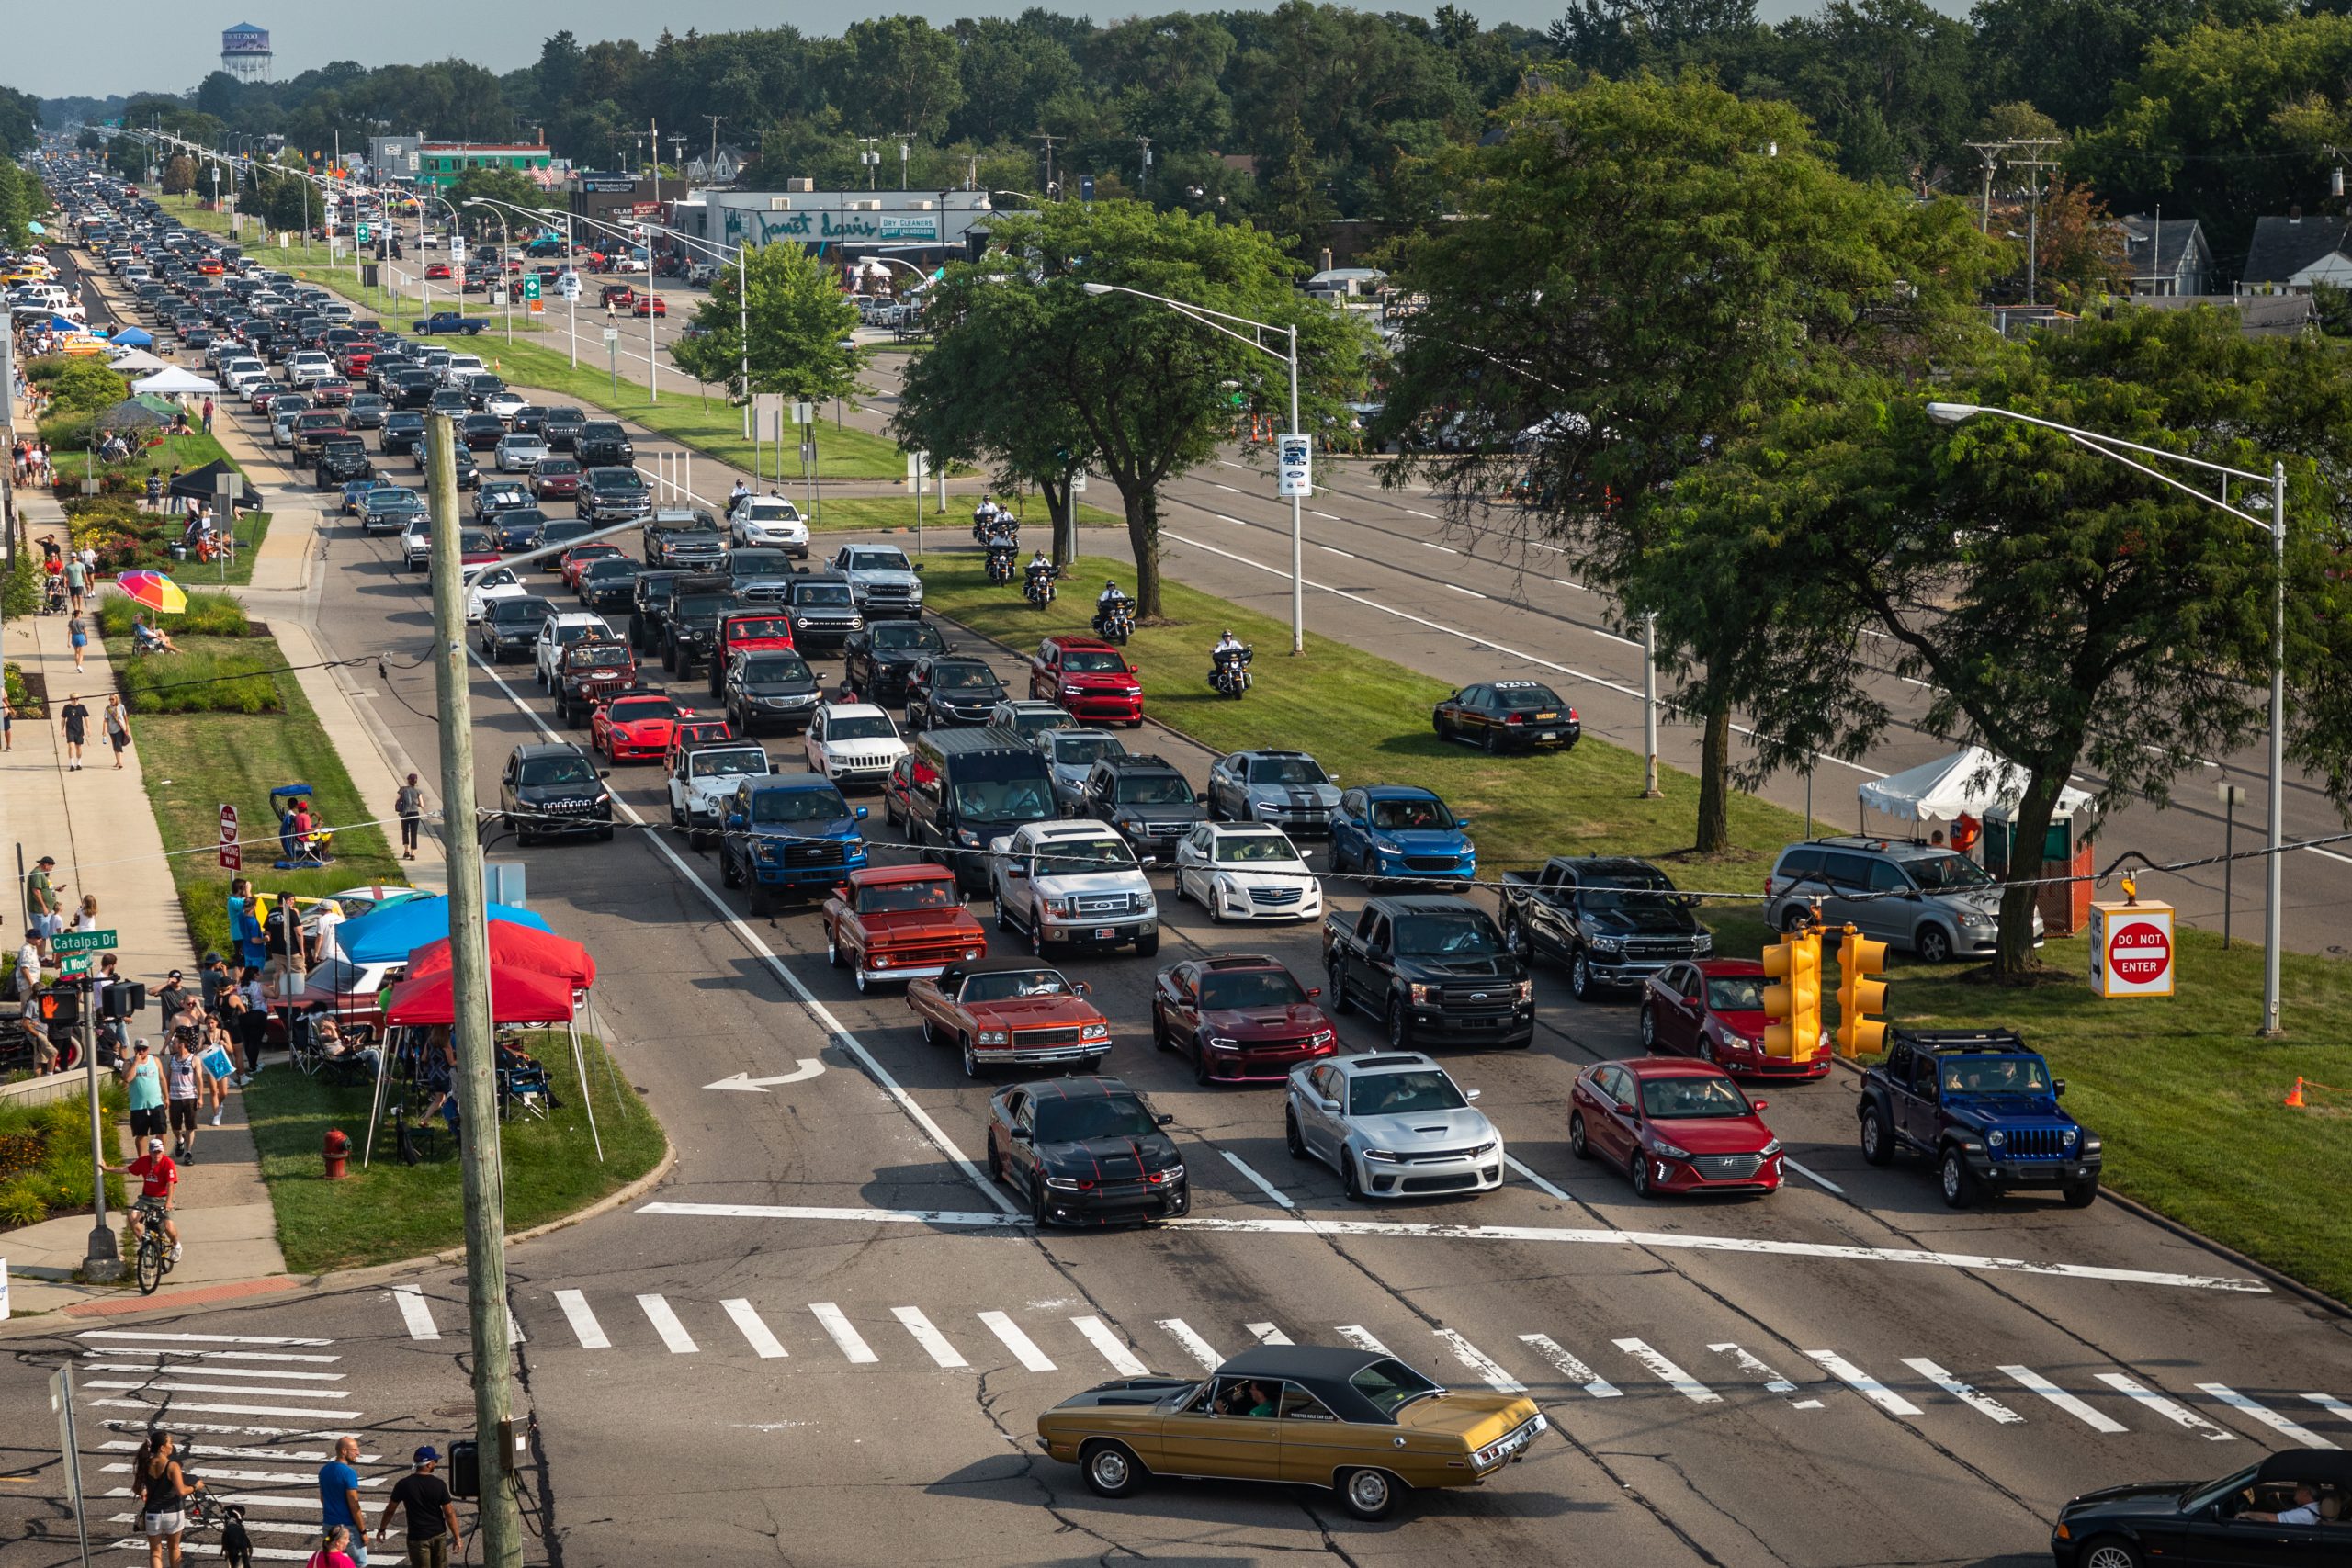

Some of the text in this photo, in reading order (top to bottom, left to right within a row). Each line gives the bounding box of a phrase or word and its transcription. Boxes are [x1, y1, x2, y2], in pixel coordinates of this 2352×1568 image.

[883, 219, 933, 227] DRY CLEANERS
[221, 845, 239, 857] WRONG
[225, 855, 236, 866] WAY
[53, 933, 117, 950] Catalpa Dr
[2092, 933, 2102, 956] WAY
[2118, 934, 2162, 945] DO NOT
[2122, 962, 2157, 973] ENTER
